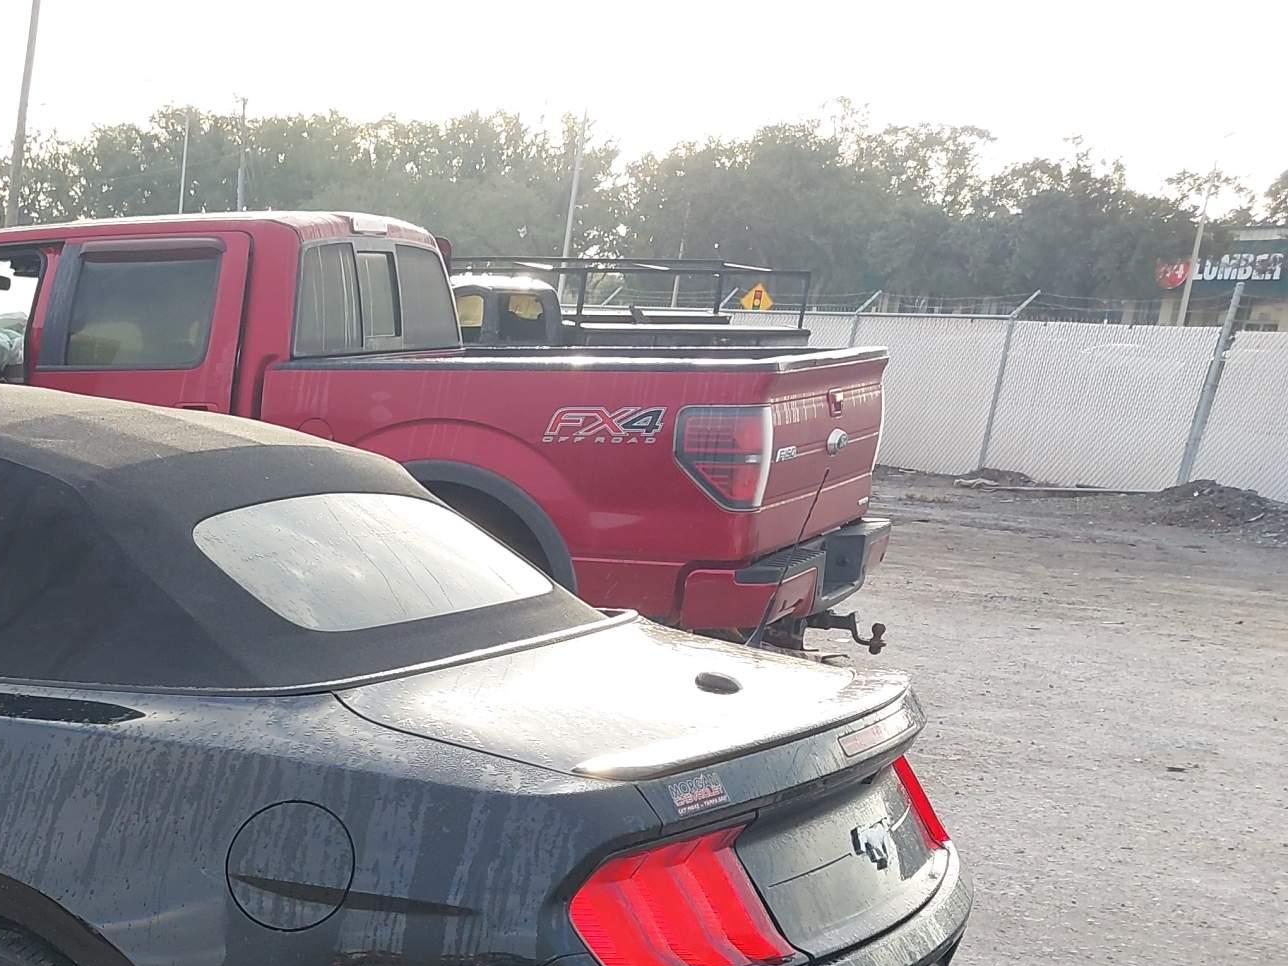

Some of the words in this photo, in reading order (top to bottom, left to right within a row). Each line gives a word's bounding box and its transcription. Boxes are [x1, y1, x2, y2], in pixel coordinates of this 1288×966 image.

[1192, 253, 1284, 281] LUMBER
[544, 407, 667, 436] FX4
[542, 436, 585, 444] OFF
[594, 436, 657, 444] ROAD
